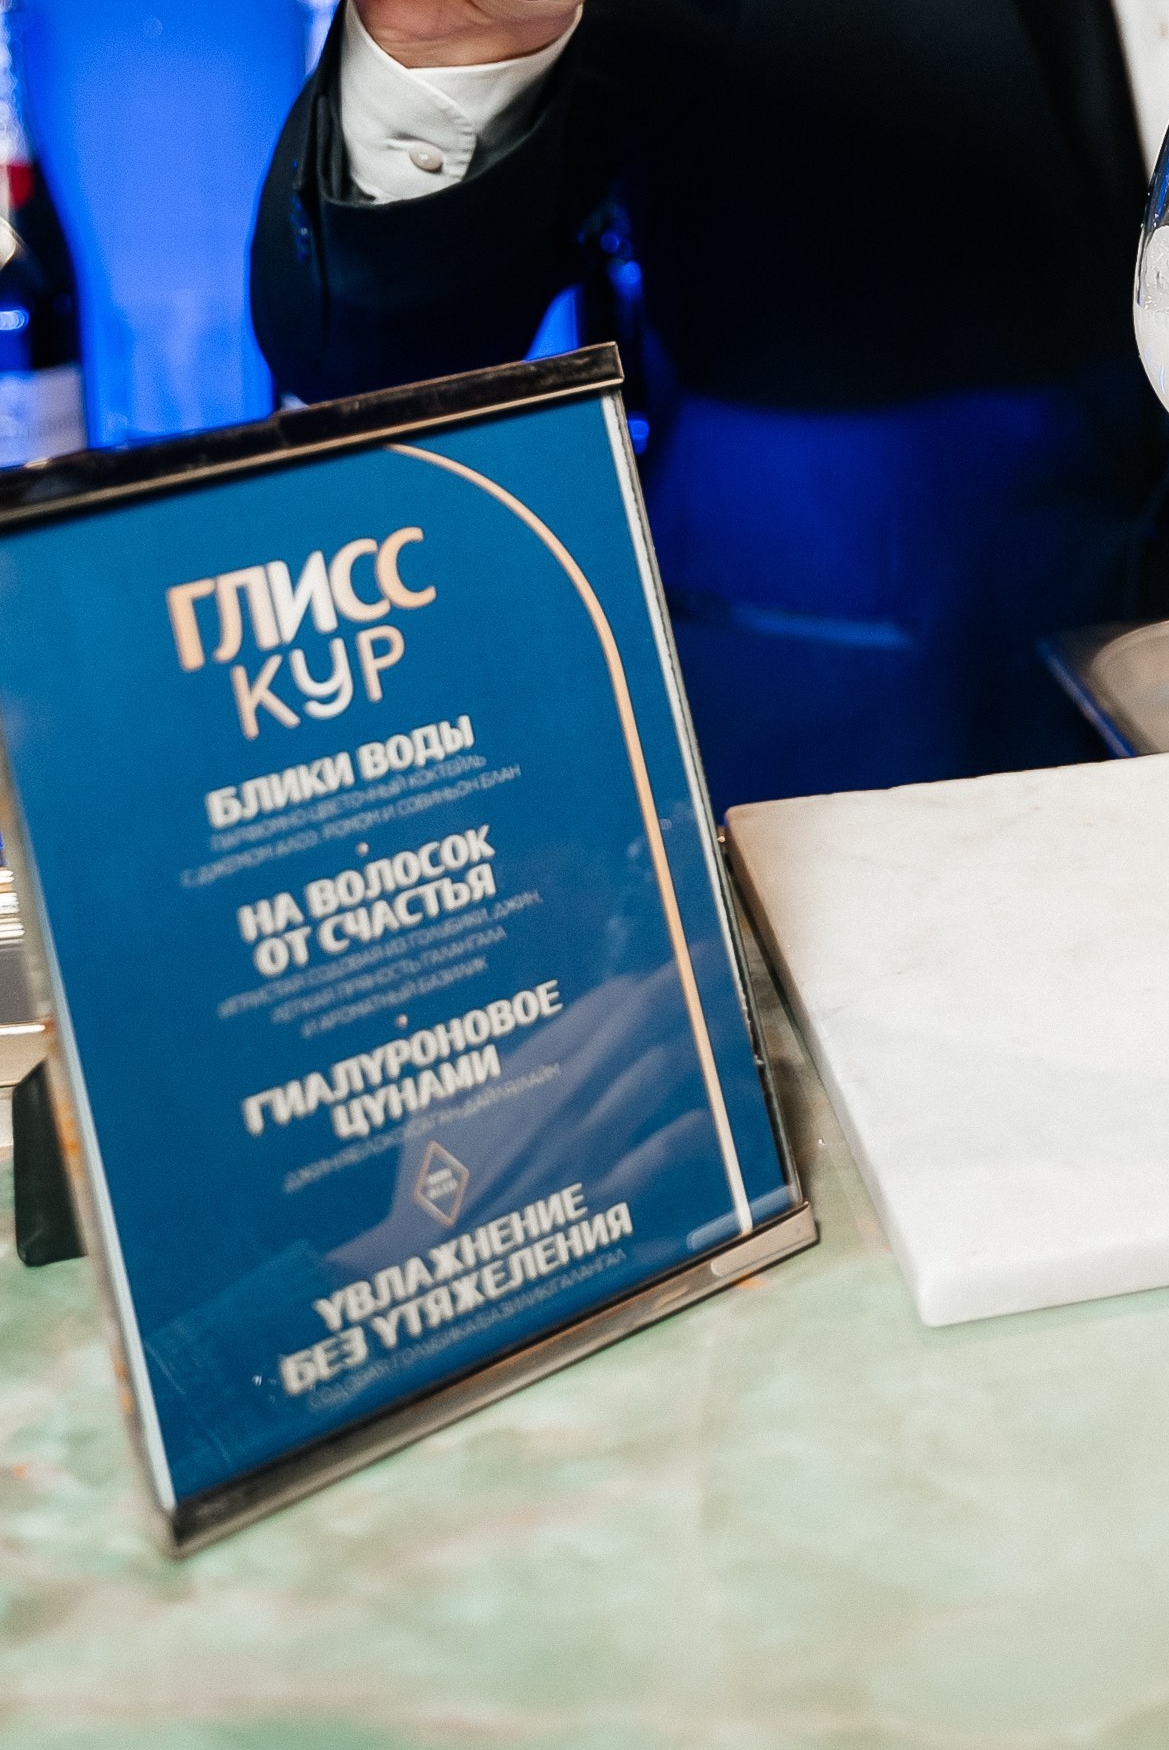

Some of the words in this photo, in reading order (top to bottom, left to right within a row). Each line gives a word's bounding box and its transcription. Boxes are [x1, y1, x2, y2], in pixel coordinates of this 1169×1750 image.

[165, 526, 437, 672] ГЛИСС
[229, 624, 406, 740] КУР
[205, 751, 355, 829] БЛИКИ
[356, 715, 475, 780] ВОДЫ
[236, 891, 305, 942] НА
[304, 824, 496, 919] ВОЛОСОК
[253, 925, 312, 978] ОТ
[316, 862, 497, 955] СЧАСТЬЯ
[240, 980, 563, 1136] ГИАЛУРОНОВОЕ
[331, 1044, 501, 1139] ЦУНАМИ
[280, 1326, 368, 1395] БЕЗ
[371, 1202, 634, 1348] УТЯЖЕЛЕНИЯ
[312, 1182, 588, 1332] УВЛАЖНЕНИЕ
